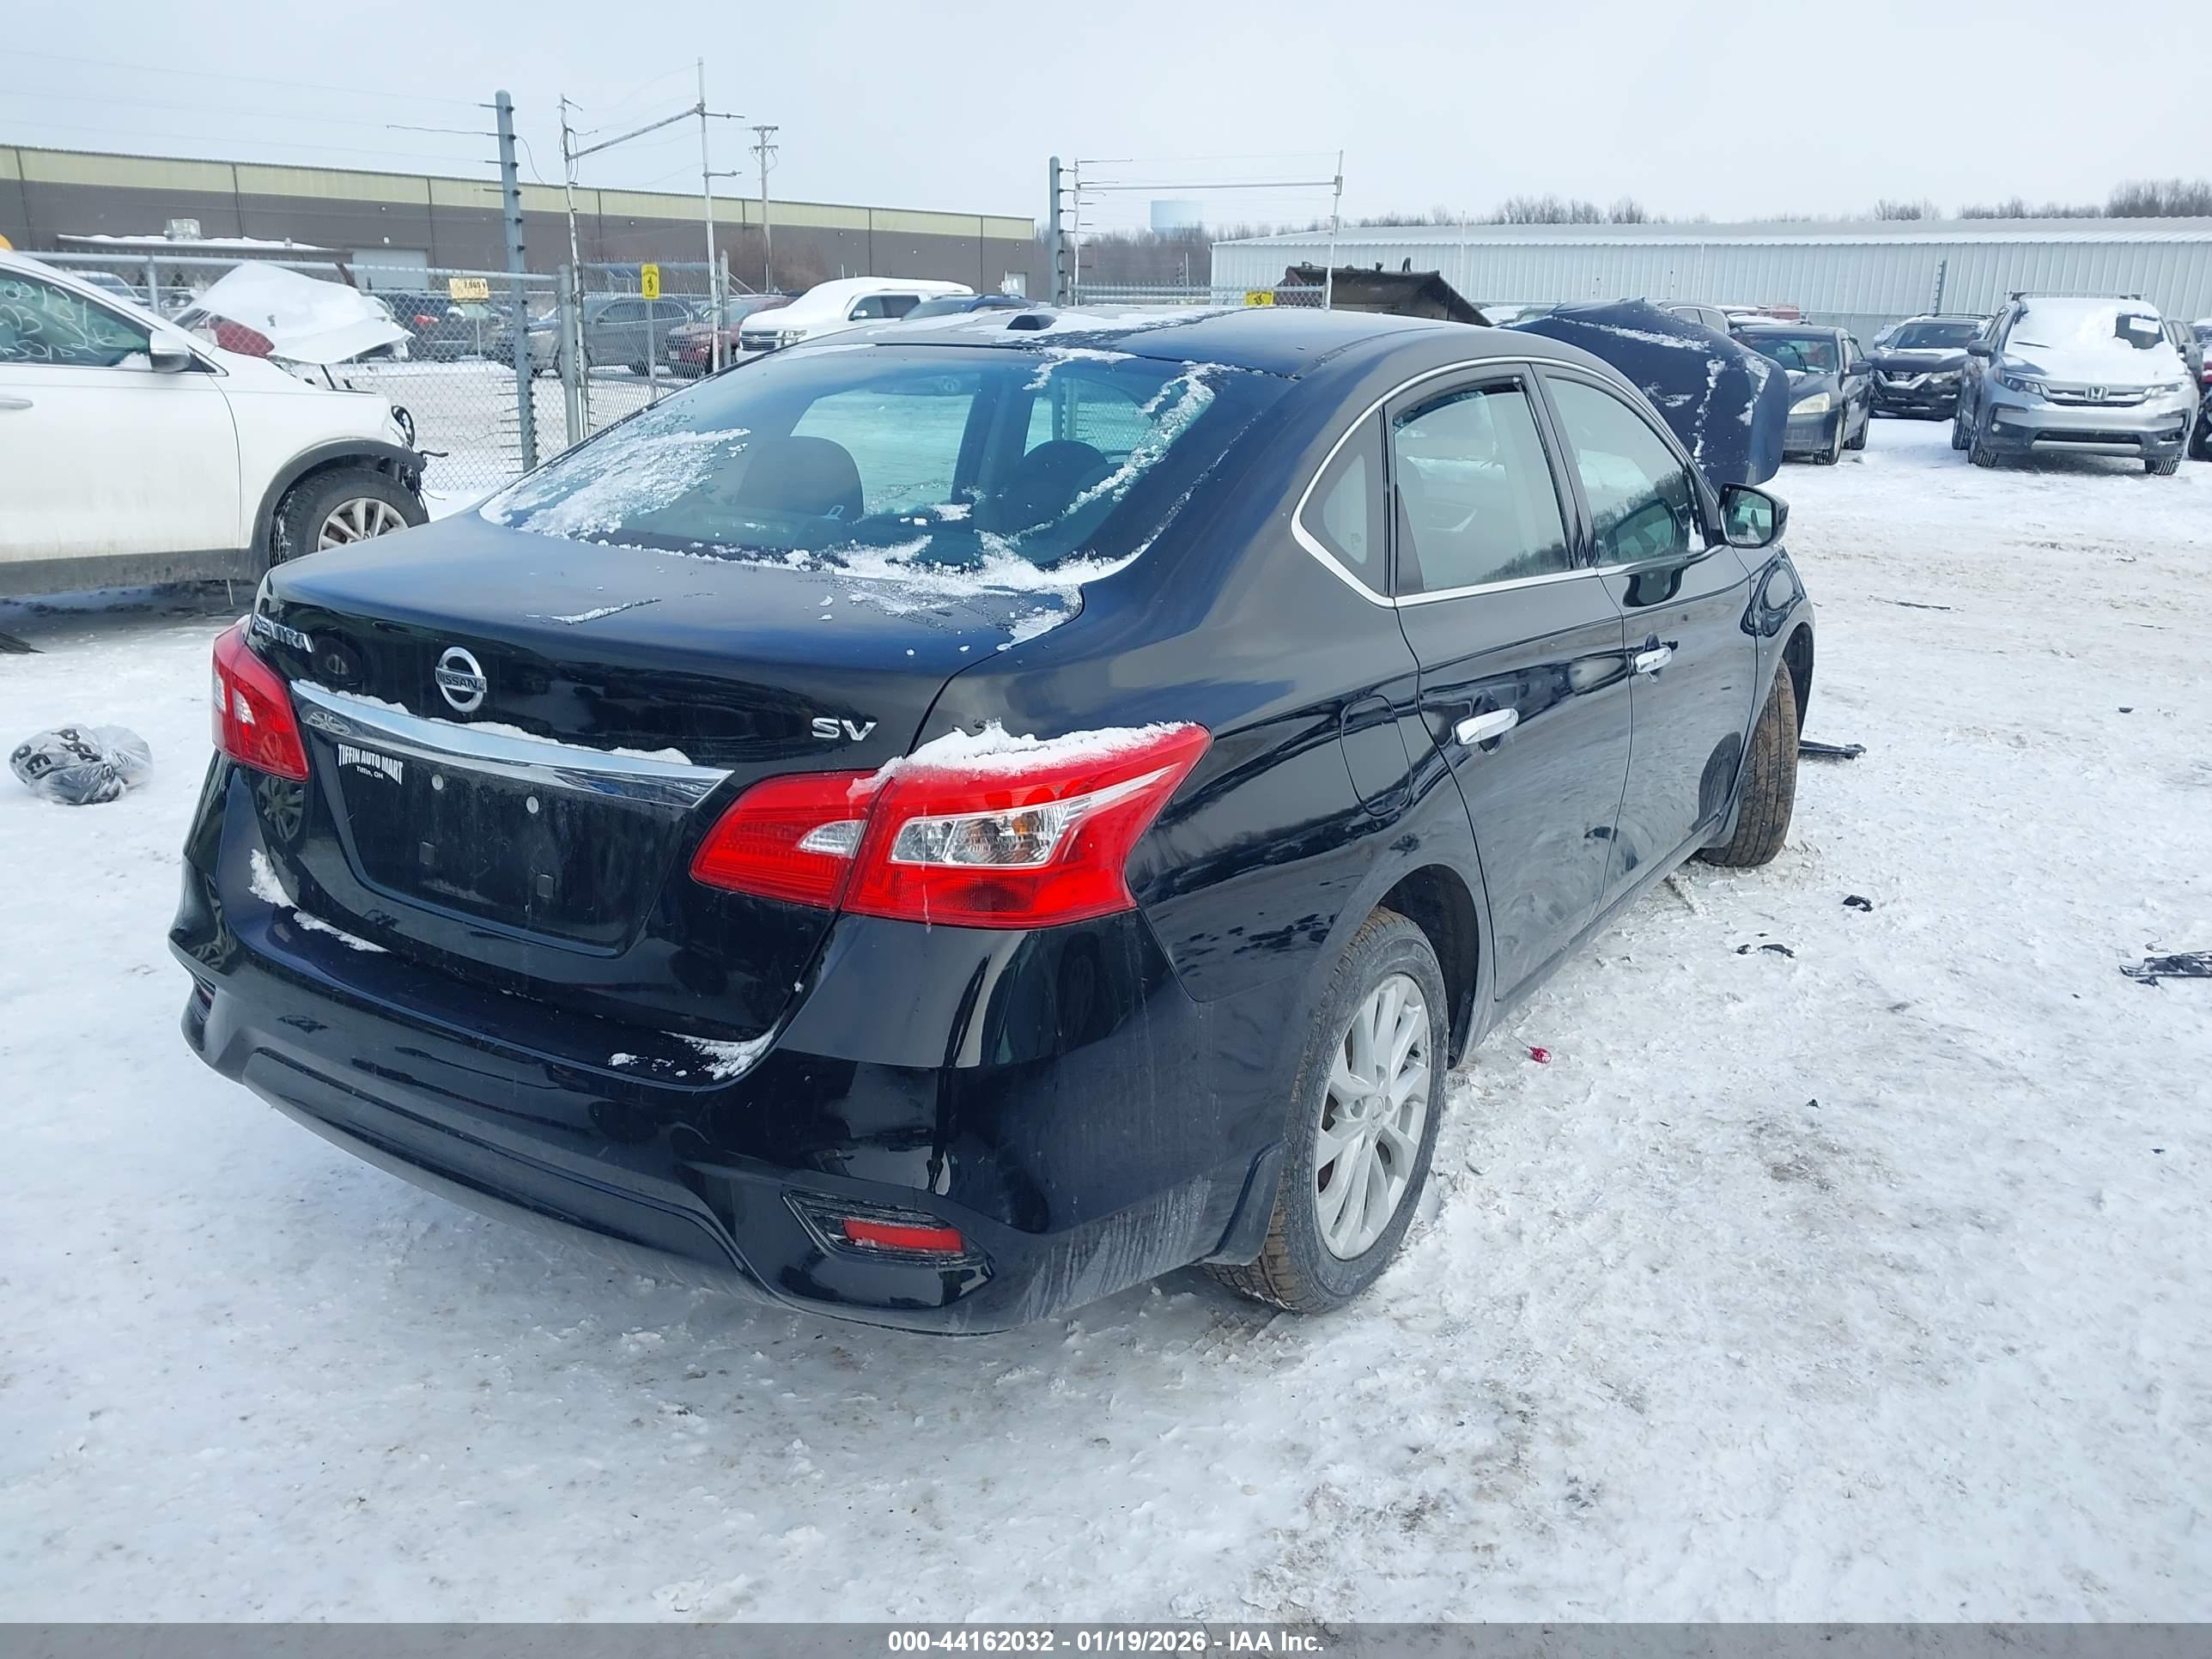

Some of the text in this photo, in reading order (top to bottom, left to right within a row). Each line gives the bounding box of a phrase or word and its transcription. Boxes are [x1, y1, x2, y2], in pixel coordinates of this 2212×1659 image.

[254, 613, 315, 653] SENTRA
[436, 672, 478, 689] NISSAN
[811, 717, 877, 741] SV
[337, 743, 404, 786] TIFFIN AUTO MART
[356, 765, 384, 780] Tiffin, OH
